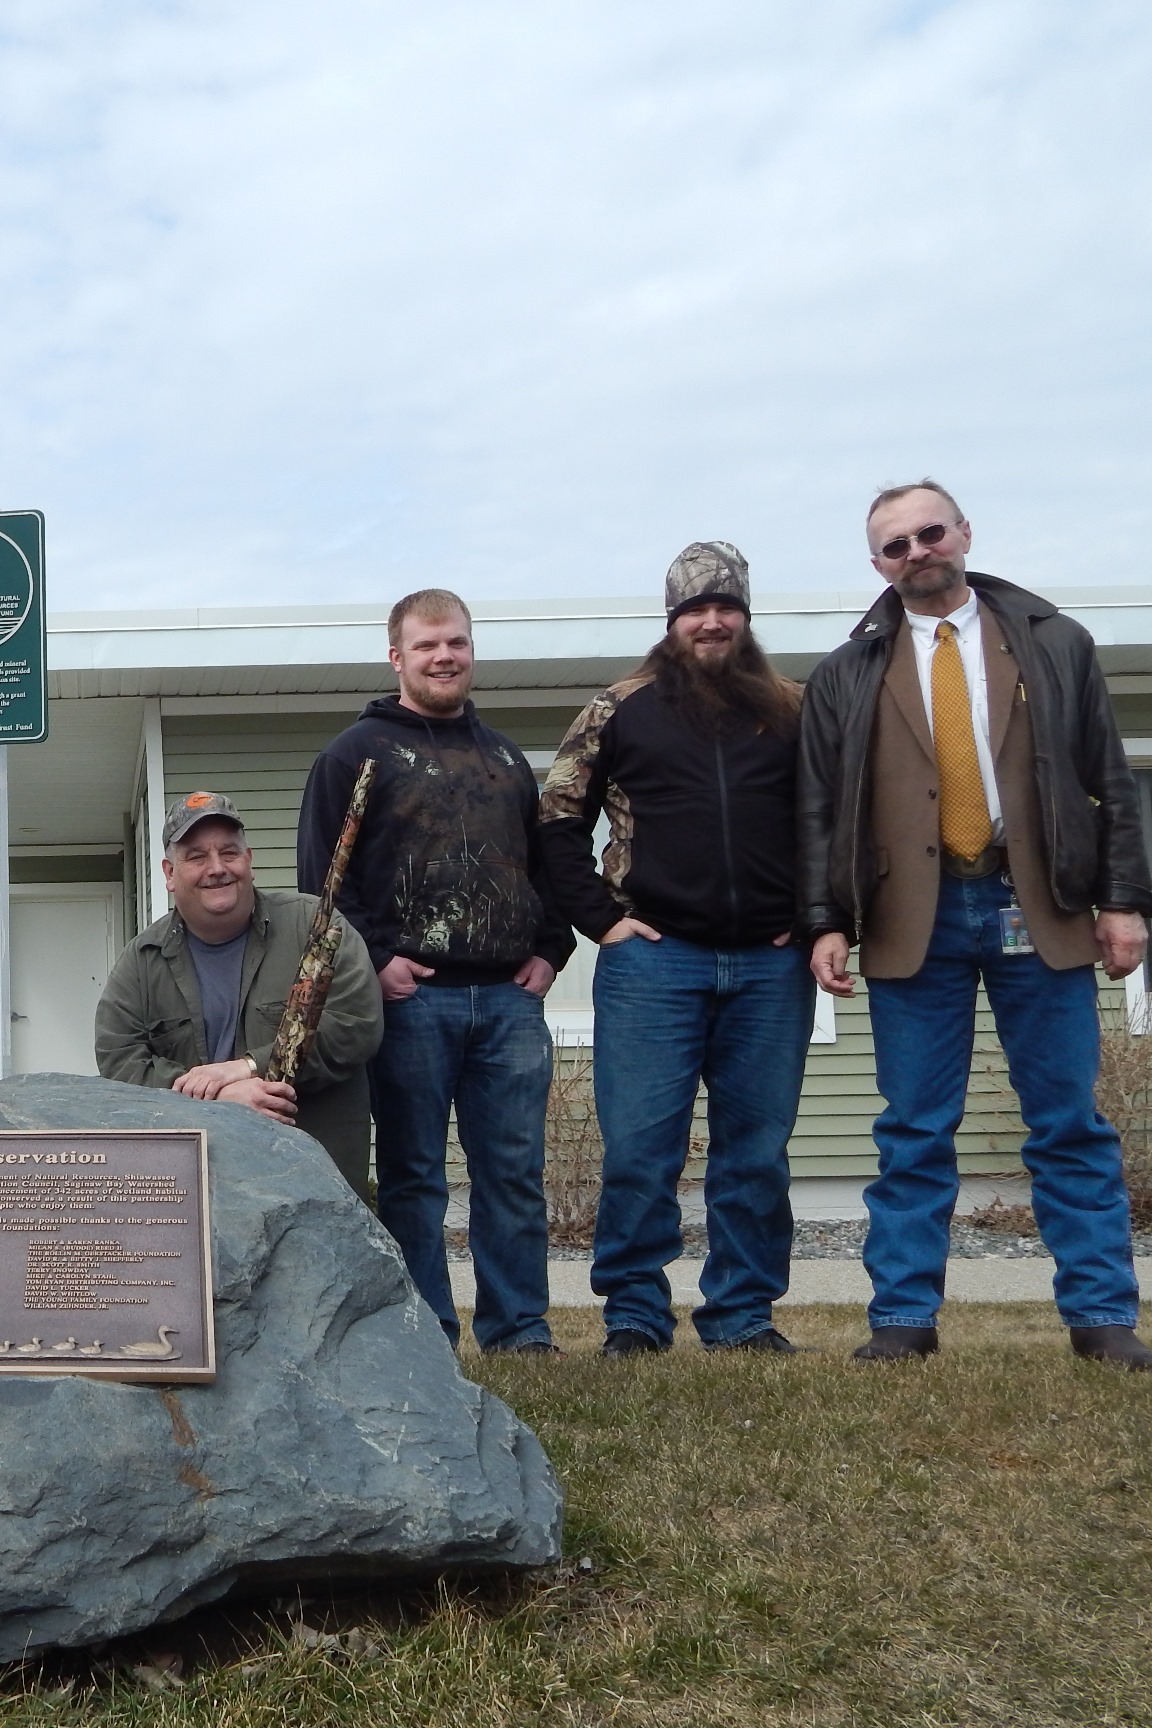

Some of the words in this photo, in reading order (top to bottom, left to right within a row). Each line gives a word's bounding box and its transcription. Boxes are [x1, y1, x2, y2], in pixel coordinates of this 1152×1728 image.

[4, 667, 30, 675] provided
[1007, 937, 1014, 946] E
[40, 1202, 66, 1210] enjoy
